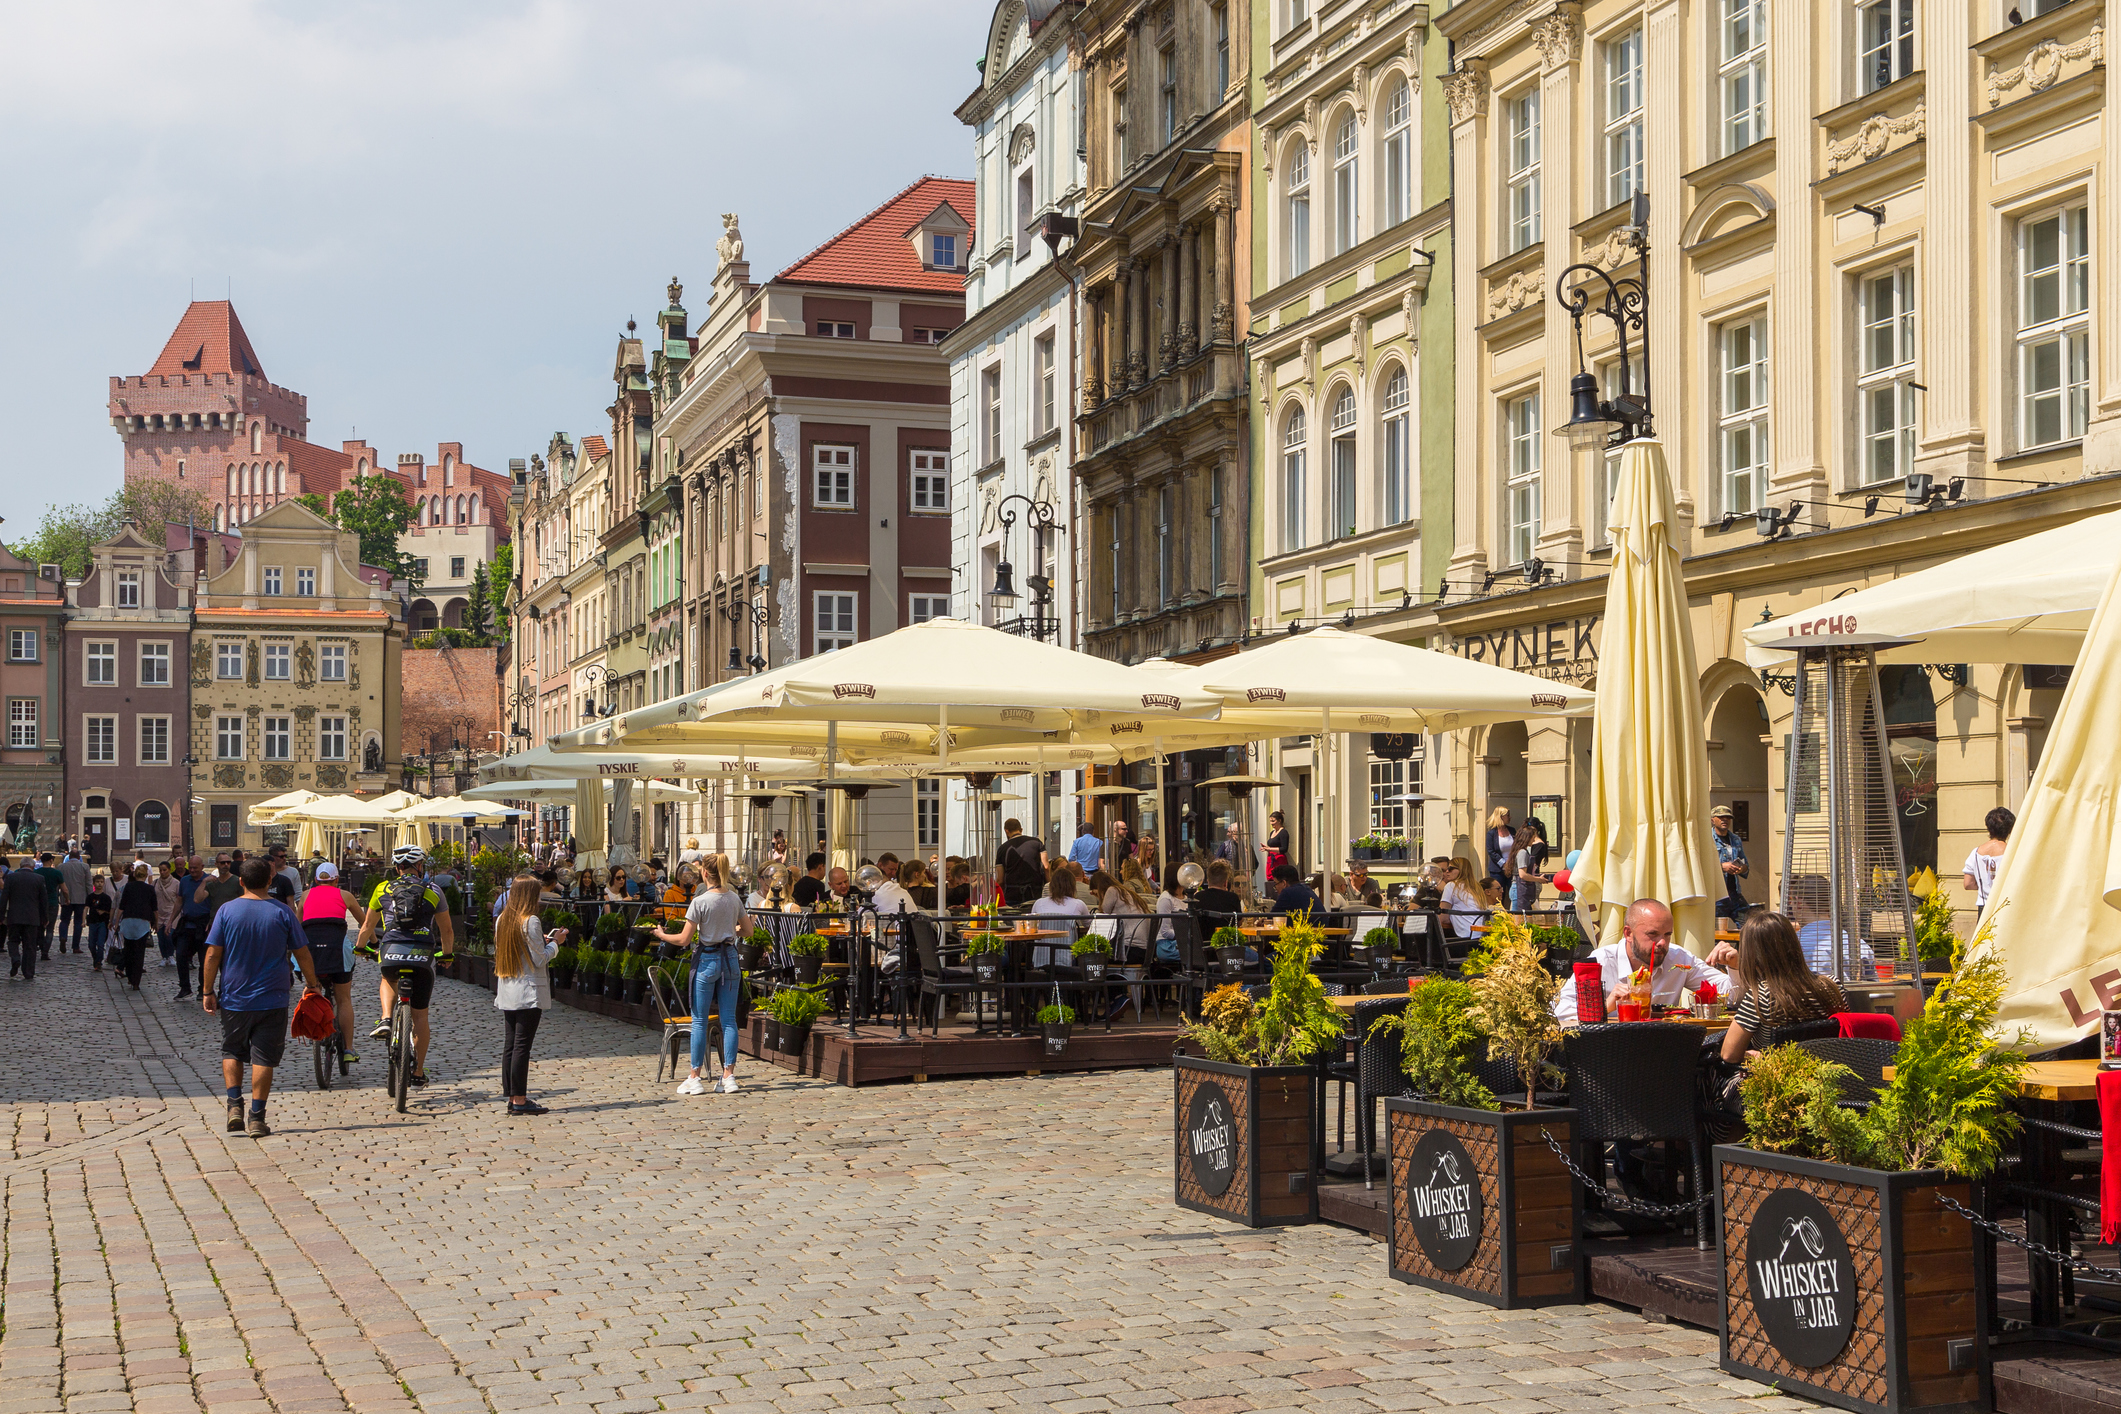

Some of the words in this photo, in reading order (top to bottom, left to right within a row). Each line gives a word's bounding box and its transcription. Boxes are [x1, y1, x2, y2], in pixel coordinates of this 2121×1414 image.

[1464, 616, 1599, 668] RYNEK
[596, 762, 640, 775] TYSKIE
[1192, 1124, 1229, 1156] WHISKEY
[1214, 1148, 1229, 1171] JAR
[1413, 1183, 1471, 1218] WHISKEY
[1449, 1212, 1470, 1239] JAR
[1756, 1258, 1840, 1300] WHISKEY
[1792, 1298, 1806, 1317] IN
[1808, 1296, 1839, 1328] JAR
